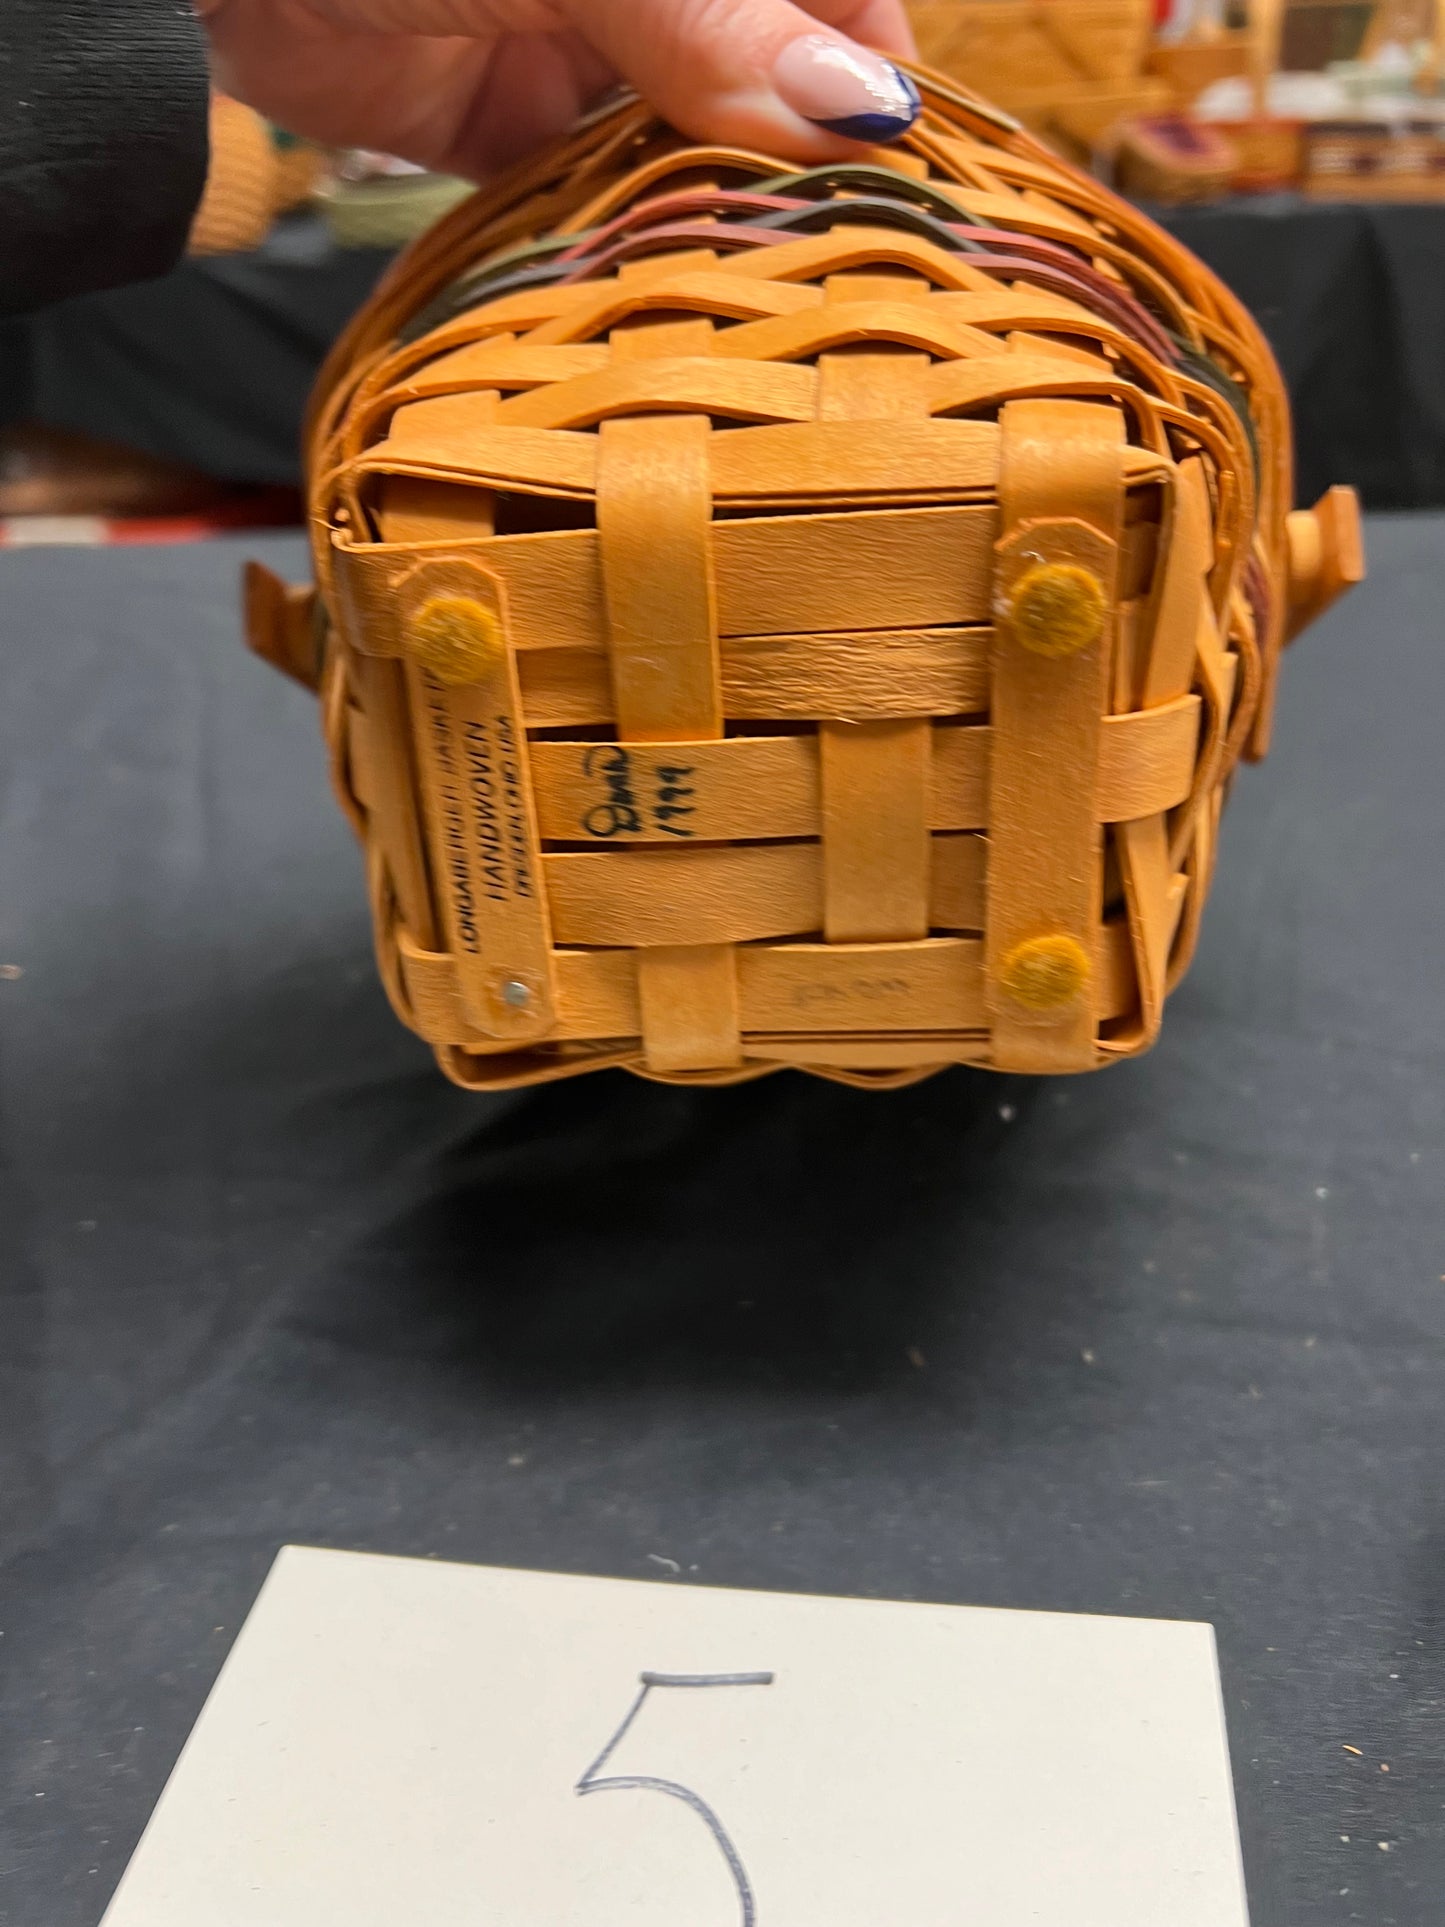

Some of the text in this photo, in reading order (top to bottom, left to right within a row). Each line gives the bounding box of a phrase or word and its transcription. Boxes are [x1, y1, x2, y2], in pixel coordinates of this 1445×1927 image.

[461, 719, 511, 901] HANDWOVEN
[654, 766, 697, 836] 1999
[574, 1670, 775, 1927] 5
